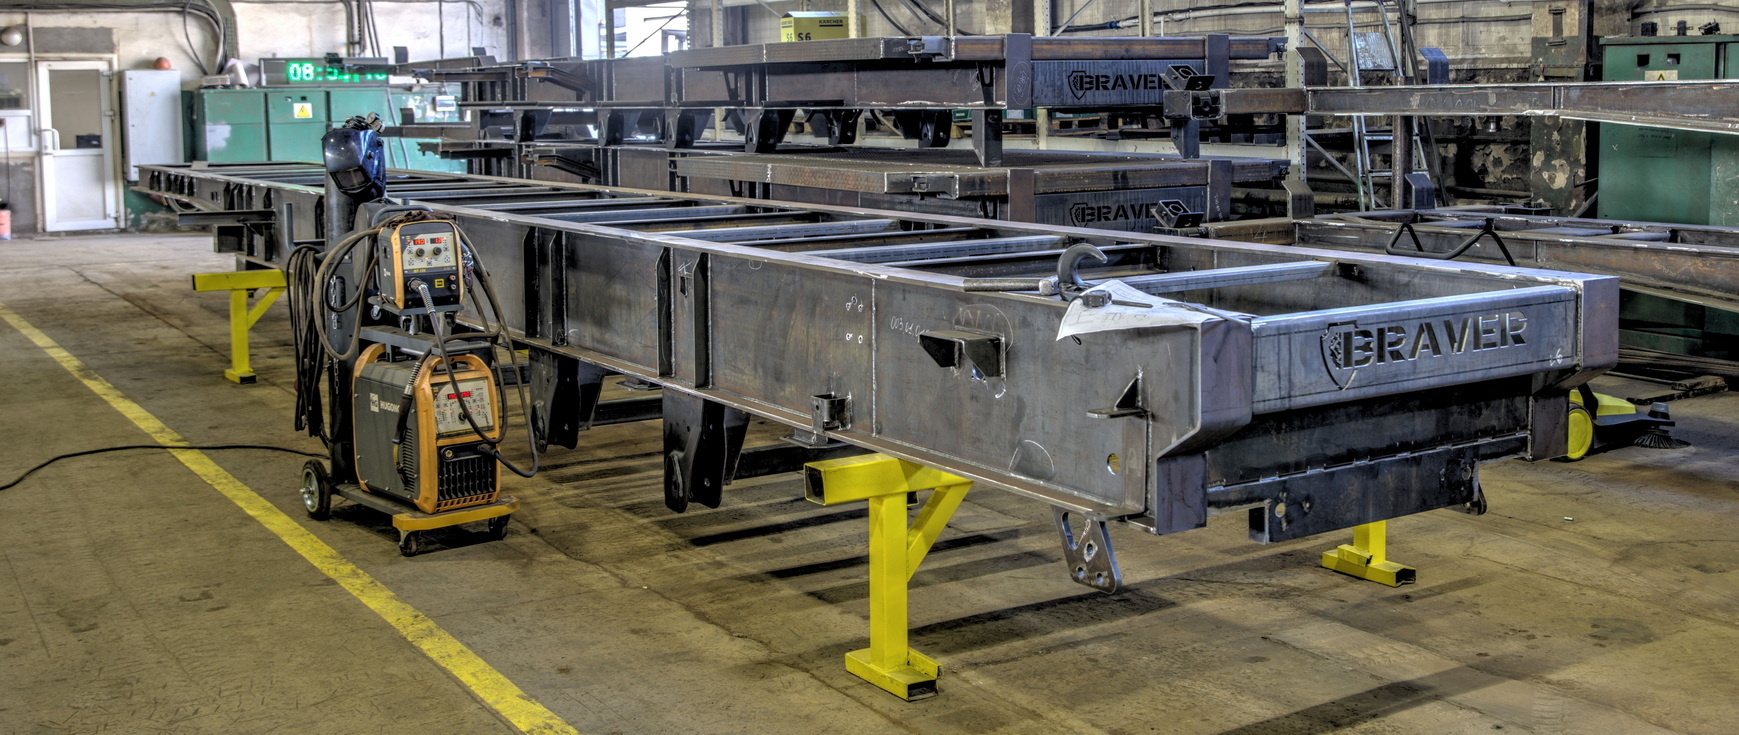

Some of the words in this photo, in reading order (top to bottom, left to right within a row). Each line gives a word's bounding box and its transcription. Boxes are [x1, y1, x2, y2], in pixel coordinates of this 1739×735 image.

[1079, 202, 1158, 223] BRAVE
[1342, 310, 1528, 370] BRAVER
[380, 400, 400, 413] HUGON
